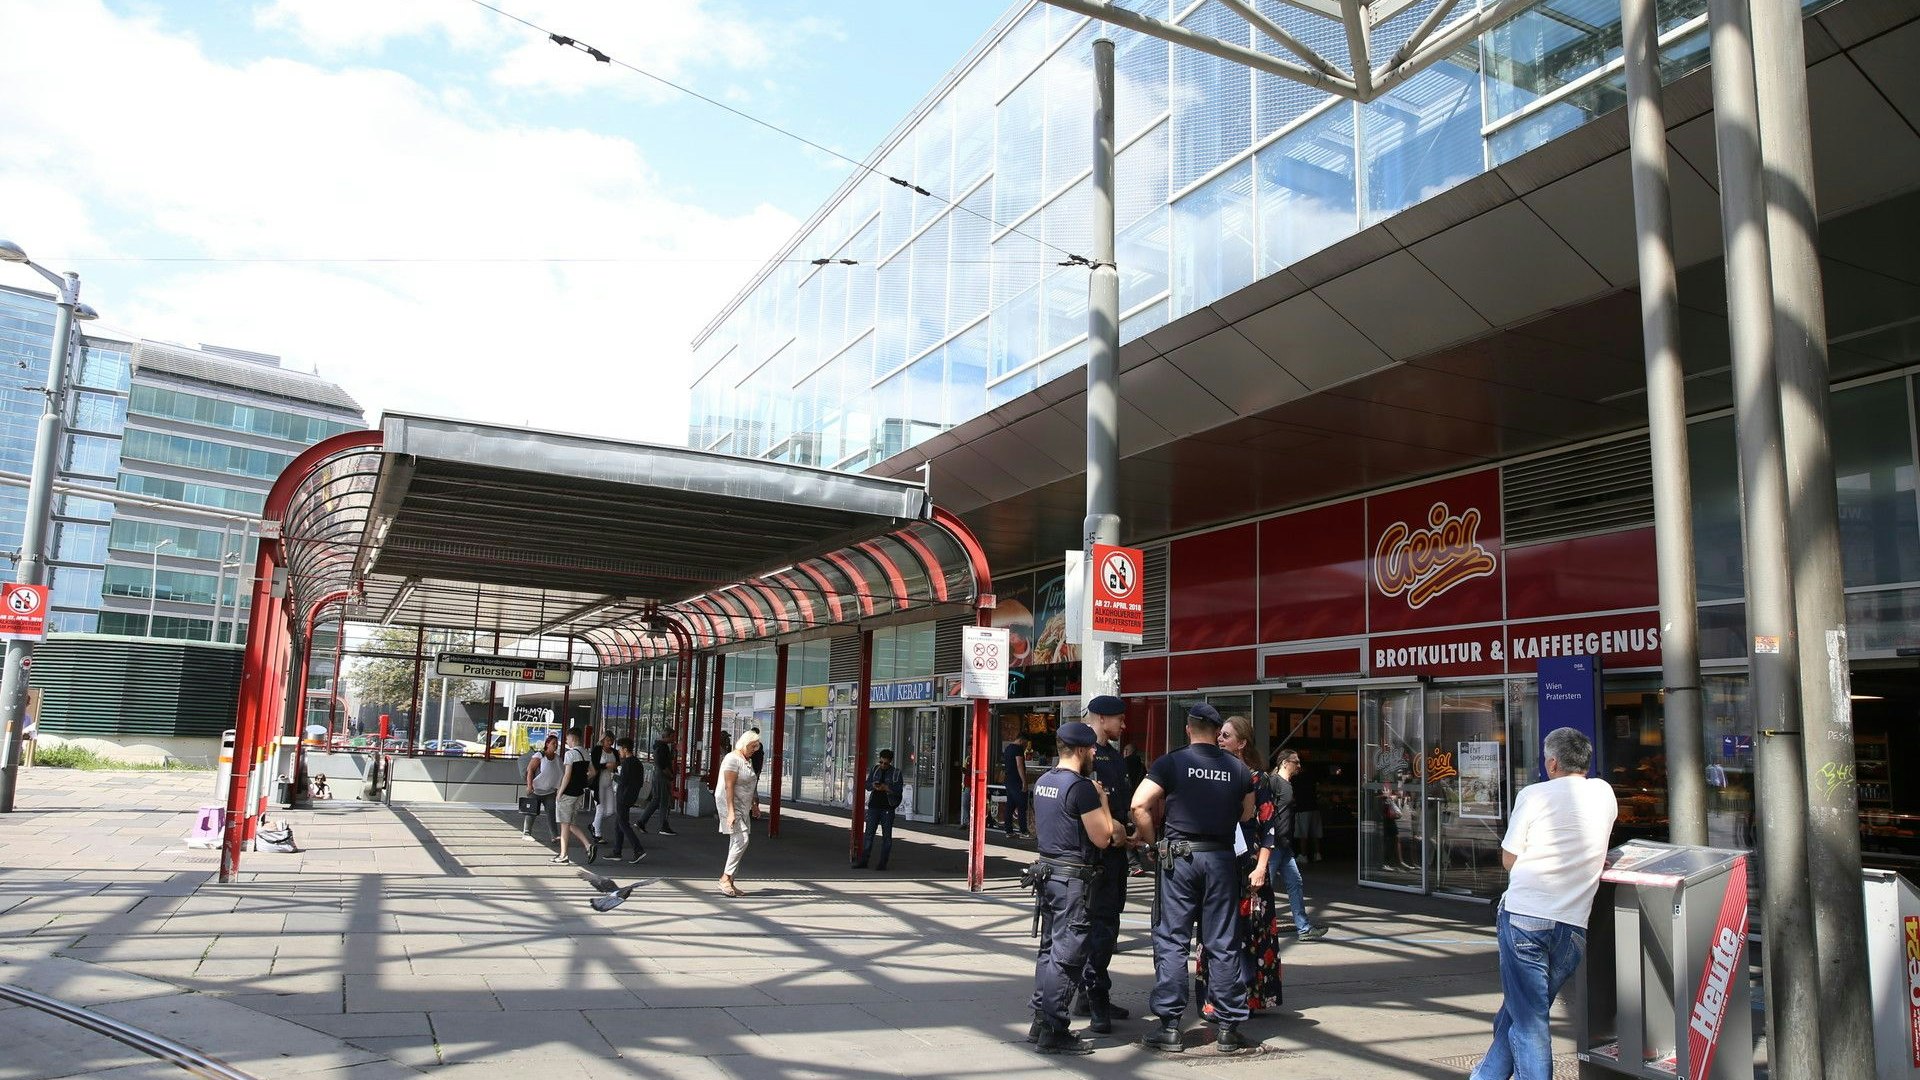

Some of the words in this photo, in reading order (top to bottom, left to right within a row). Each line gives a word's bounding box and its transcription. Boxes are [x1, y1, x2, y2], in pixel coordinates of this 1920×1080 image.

[1375, 502, 1496, 609] Geier
[1094, 608, 1141, 619] ALKOHOLVERBOT
[1105, 618, 1141, 627] PRATERSTERN
[1376, 640, 1482, 668] BROTKULTUR
[1490, 639, 1504, 661] &
[1513, 627, 1661, 659] KAFFEEGENUS
[463, 664, 521, 678] Praterstern
[523, 669, 533, 679] U1
[535, 670, 545, 679] U2
[897, 682, 923, 700] KEBAP
[1545, 682, 1562, 690] Wien
[1188, 768, 1231, 782] POLIZEI
[1035, 785, 1059, 799] POLIZEI
[1690, 927, 1738, 1041] Heute
